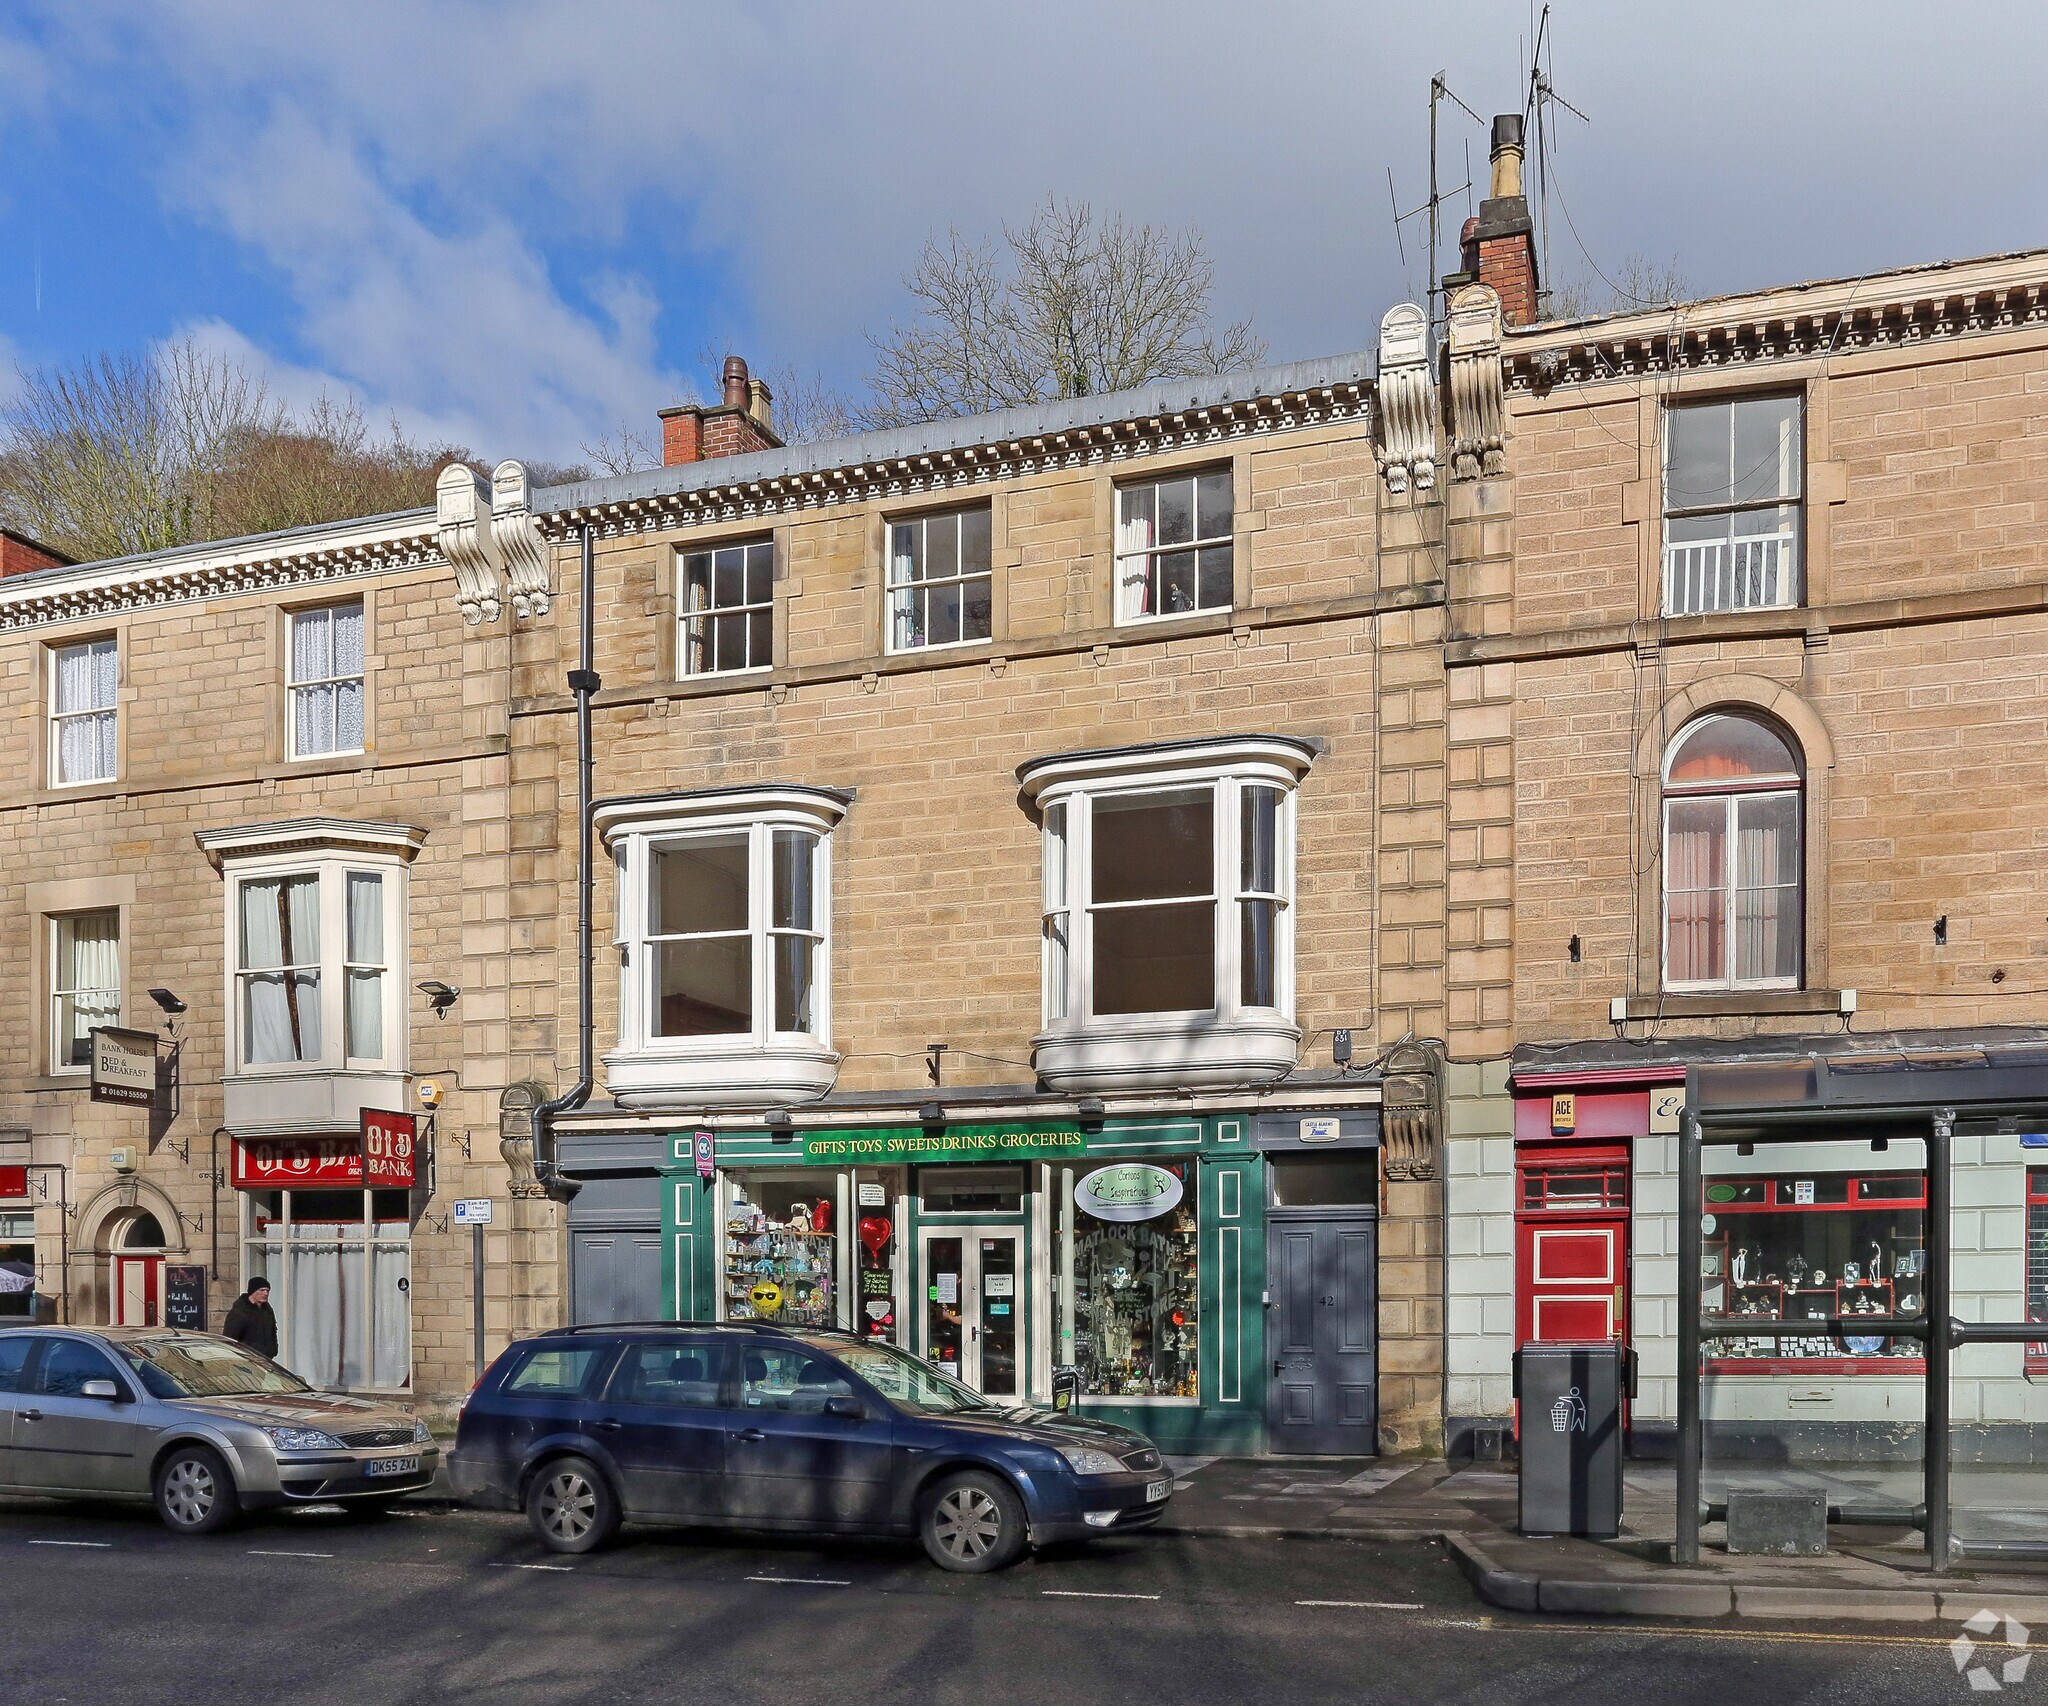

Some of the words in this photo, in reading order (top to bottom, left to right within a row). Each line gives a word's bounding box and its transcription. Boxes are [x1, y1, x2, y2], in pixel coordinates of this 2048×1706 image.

[1335, 1034, 1348, 1043] 631
[101, 1043, 122, 1054] BANK
[123, 1046, 149, 1057] HOUSE
[108, 1088, 128, 1097] 01629
[128, 1091, 148, 1099] 55550
[1555, 1100, 1571, 1115] ACE
[367, 1126, 412, 1161] OLD
[808, 1140, 846, 1154] GIFTS
[848, 1139, 882, 1153] TOYS
[887, 1137, 940, 1152] SWEETS
[941, 1135, 996, 1150] DRINKS
[999, 1132, 1081, 1148] GROCERIES
[256, 1143, 311, 1175] OLD
[315, 1139, 362, 1173] BAN
[368, 1158, 412, 1177] BANK
[1073, 1225, 1137, 1260] MATLOCK
[1140, 1228, 1176, 1257] BATH
[1319, 1295, 1334, 1306] 42
[372, 1460, 397, 1473] DK55
[400, 1458, 416, 1471] ZXA
